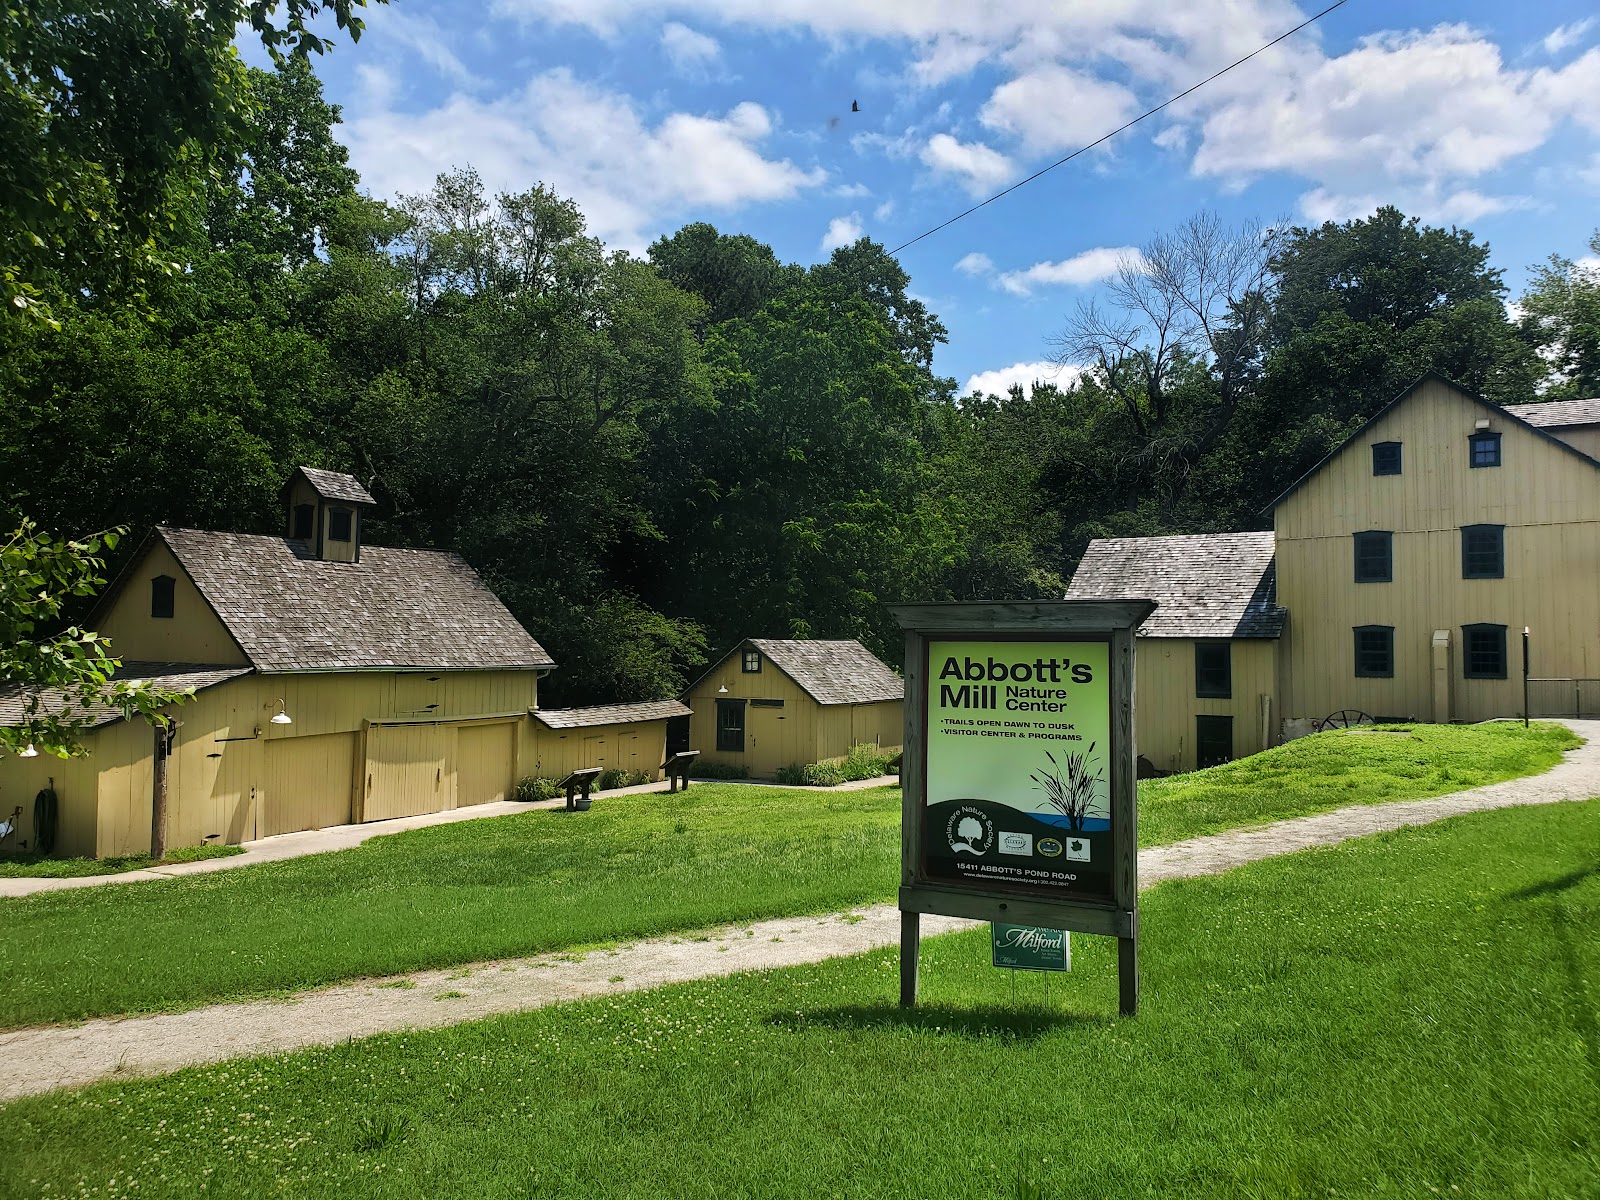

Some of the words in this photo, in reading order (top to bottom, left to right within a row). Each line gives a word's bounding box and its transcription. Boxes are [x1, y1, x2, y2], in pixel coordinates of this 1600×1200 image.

[939, 657, 1093, 684] Abbott's
[940, 684, 997, 710] Mill
[1006, 686, 1067, 699] Nature
[1005, 698, 1067, 712] Center
[944, 718, 974, 726] TRAILS
[976, 719, 1001, 727] OPEN
[944, 728, 979, 736] VISITOR
[980, 730, 1016, 738] CENTER
[1028, 732, 1082, 741] PROGRAMS
[945, 809, 961, 846] Delaware
[961, 806, 987, 820] Nature
[983, 820, 994, 850] Society
[956, 862, 978, 871] 15411
[980, 865, 1022, 875] ABBOTT'S
[1024, 869, 1050, 878] POND
[1052, 872, 1077, 881] ROAD
[996, 927, 1062, 953] Milford
